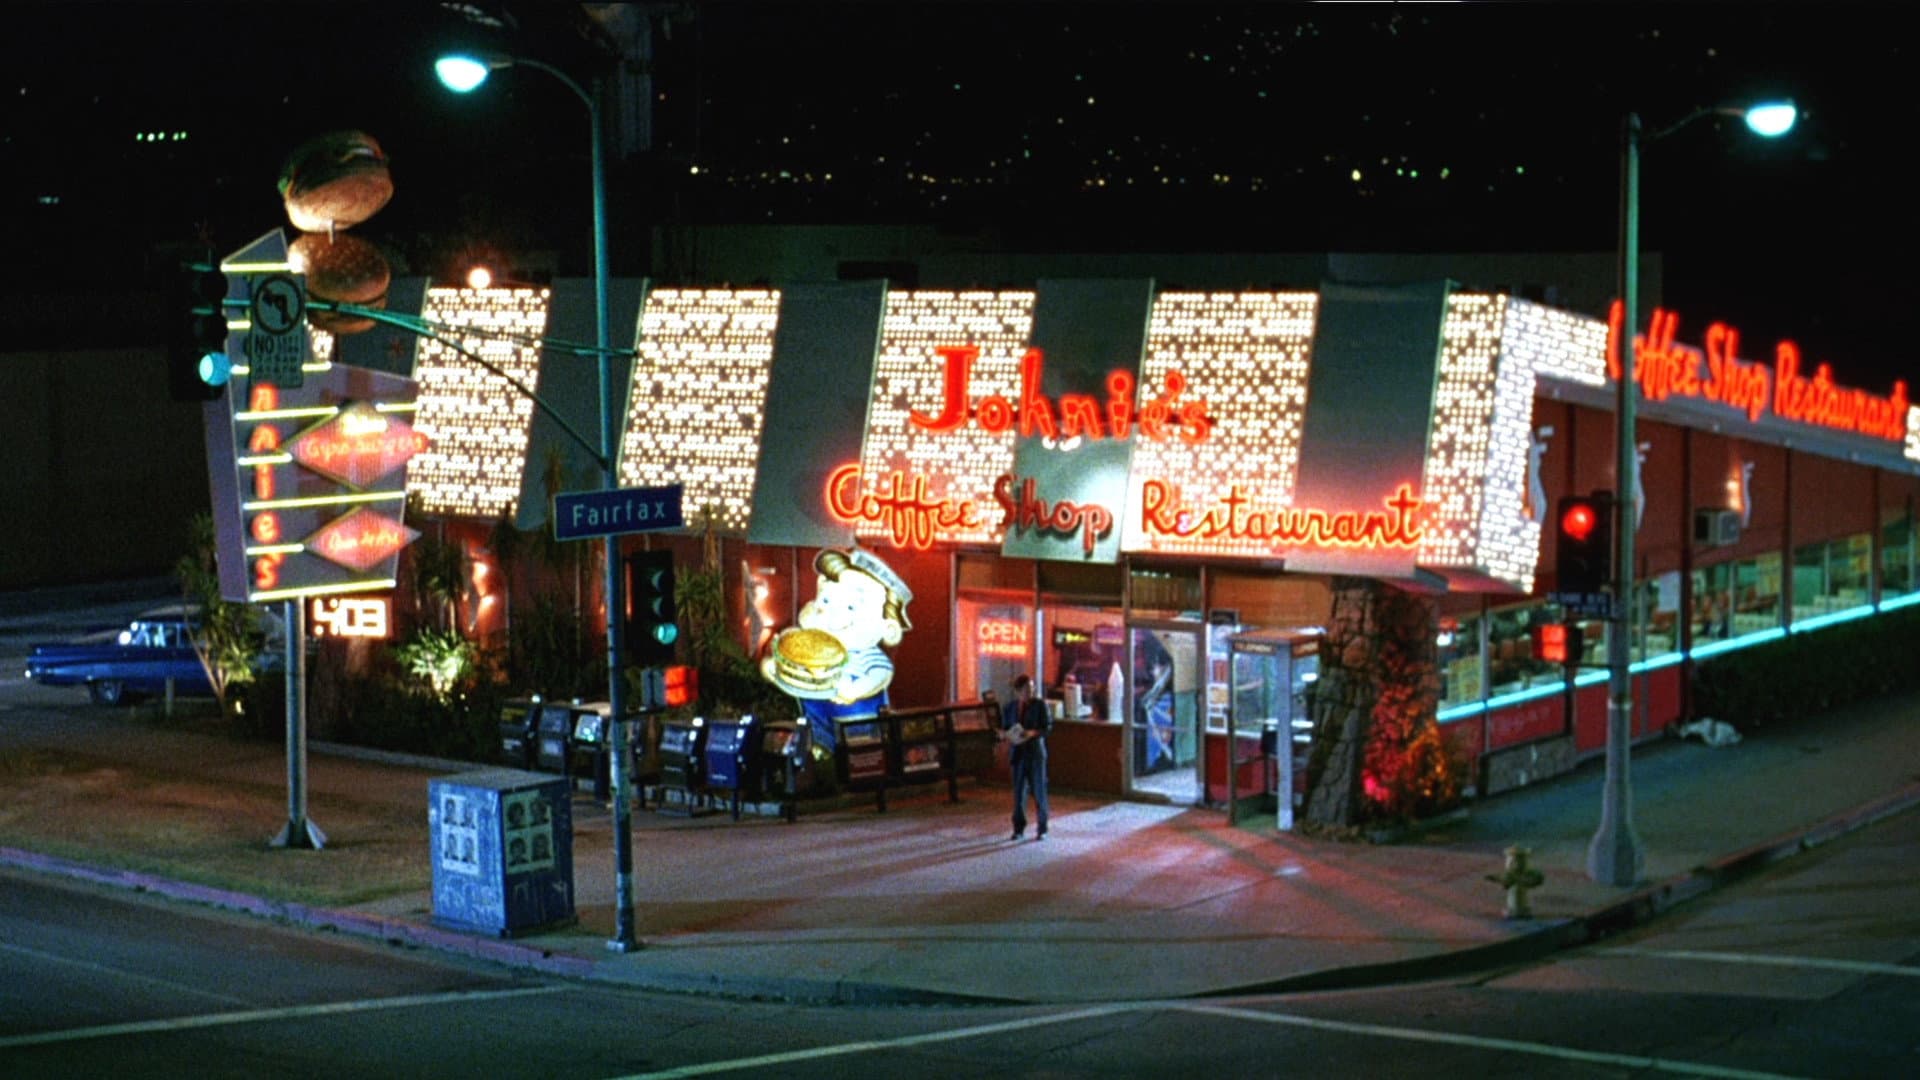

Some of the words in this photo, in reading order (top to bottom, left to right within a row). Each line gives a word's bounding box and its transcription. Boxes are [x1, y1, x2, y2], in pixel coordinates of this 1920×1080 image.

[909, 342, 1214, 444] Johnie's
[1703, 322, 1767, 422] Shop
[1773, 340, 1907, 440] Restaurant
[572, 499, 665, 528] Fairfax
[827, 463, 982, 549] Coffee
[994, 473, 1115, 554] Shop
[1141, 479, 1424, 548] Restaurant
[979, 623, 1027, 641] OPEN
